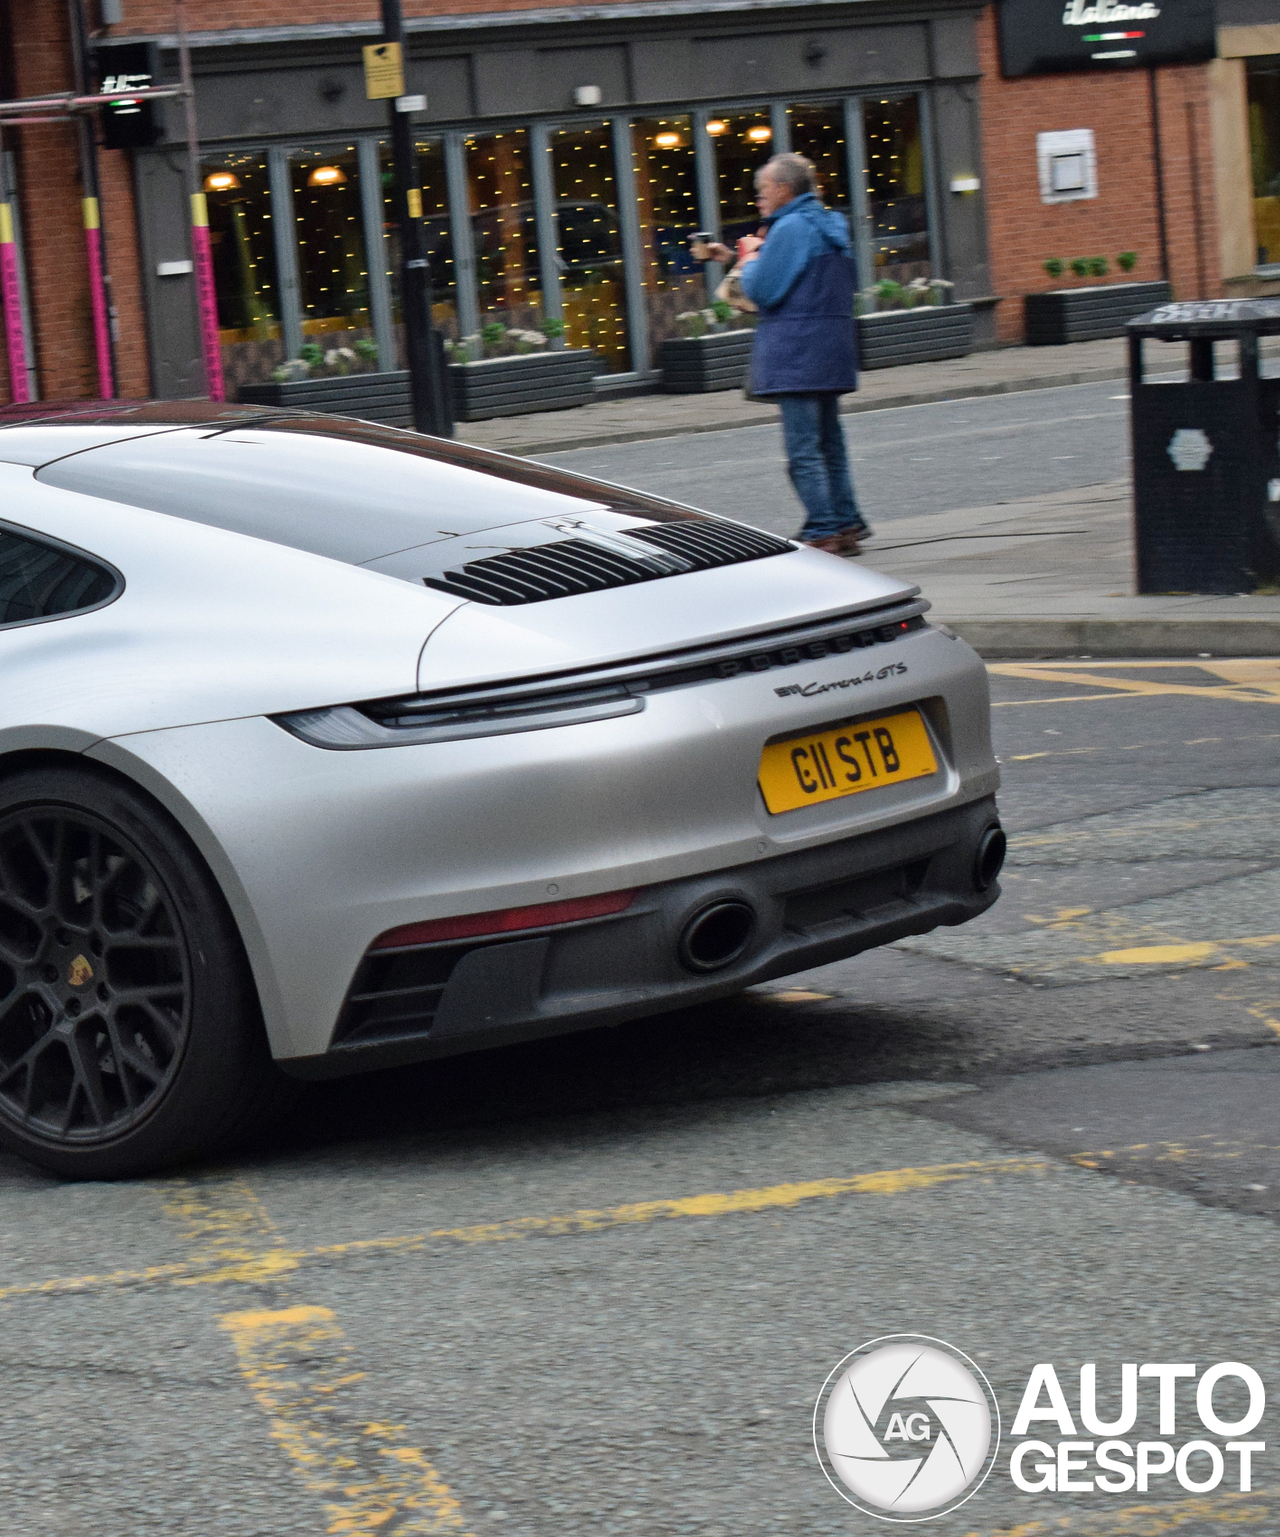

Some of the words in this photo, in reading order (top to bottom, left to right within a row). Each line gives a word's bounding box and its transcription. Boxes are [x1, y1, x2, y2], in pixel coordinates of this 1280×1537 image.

[720, 626, 897, 678] PORSCHE
[801, 677, 863, 697] Carrera
[863, 670, 874, 681] 4
[875, 661, 907, 680] GTS
[835, 727, 901, 782] STB
